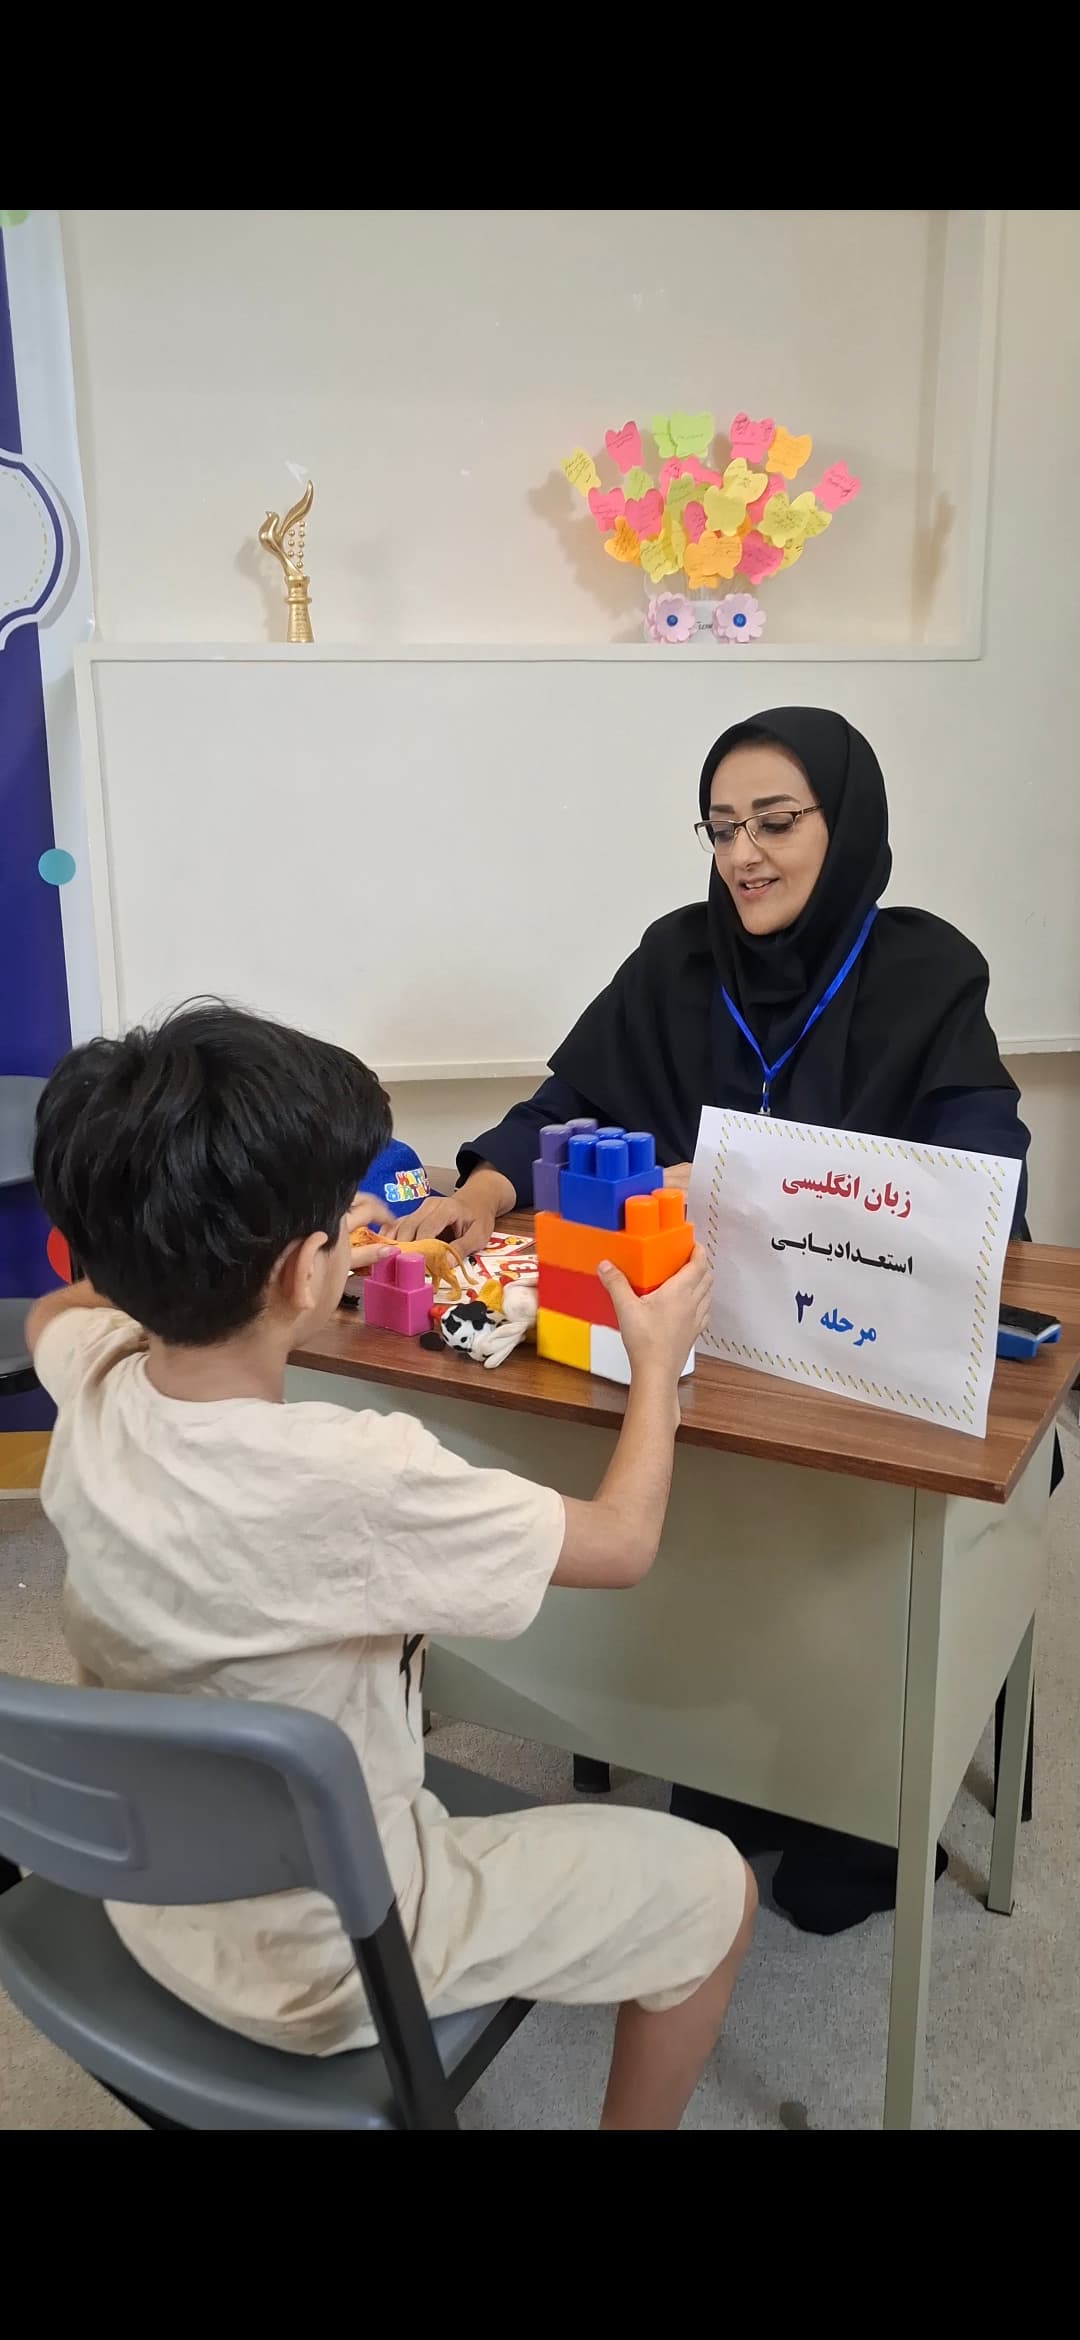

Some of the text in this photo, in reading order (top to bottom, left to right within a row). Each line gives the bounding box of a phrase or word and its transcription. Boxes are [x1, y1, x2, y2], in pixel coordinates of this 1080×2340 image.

[781, 1171, 912, 1218] زبان انگلیسی
[771, 1232, 913, 1276] استعدادیابی
[794, 1290, 877, 1347] مرحله ۳
